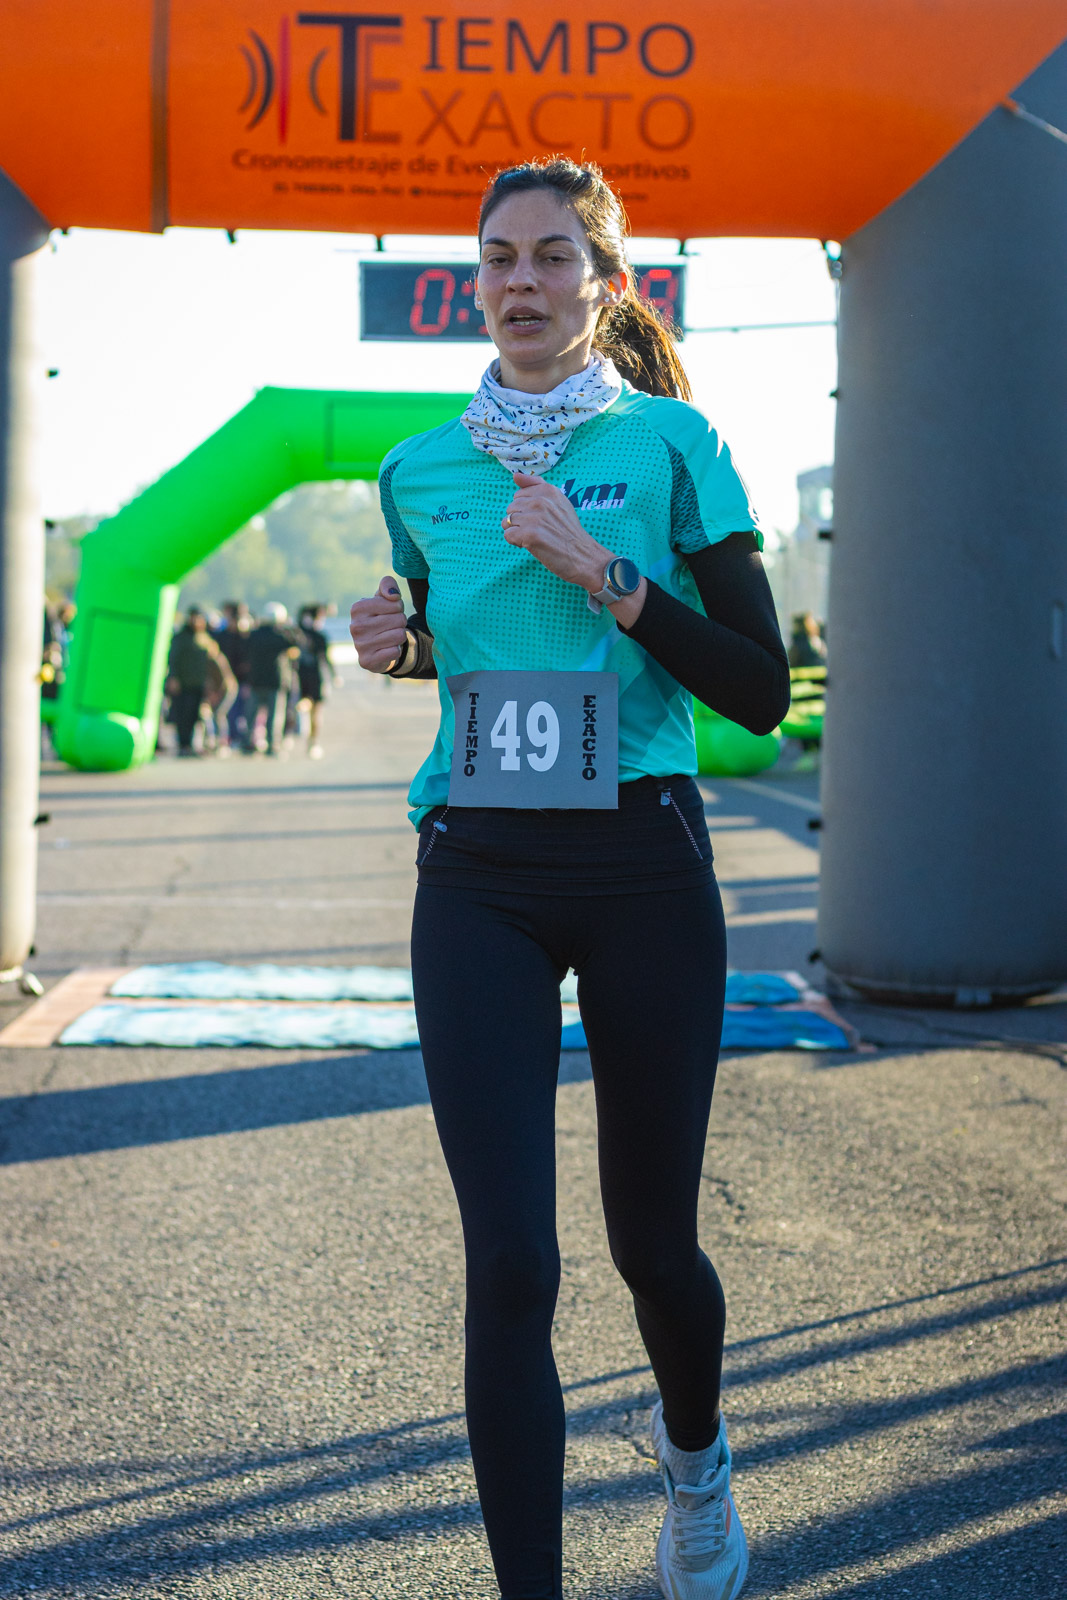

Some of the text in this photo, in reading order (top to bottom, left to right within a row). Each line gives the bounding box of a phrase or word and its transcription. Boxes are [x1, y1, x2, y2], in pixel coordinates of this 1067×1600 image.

[232, 149, 402, 177] Cronometraje
[408, 156, 440, 174] de
[581, 496, 626, 511] team
[464, 692, 480, 777] TIEMPO
[490, 700, 560, 772] 49
[581, 694, 597, 781] EXACTO
